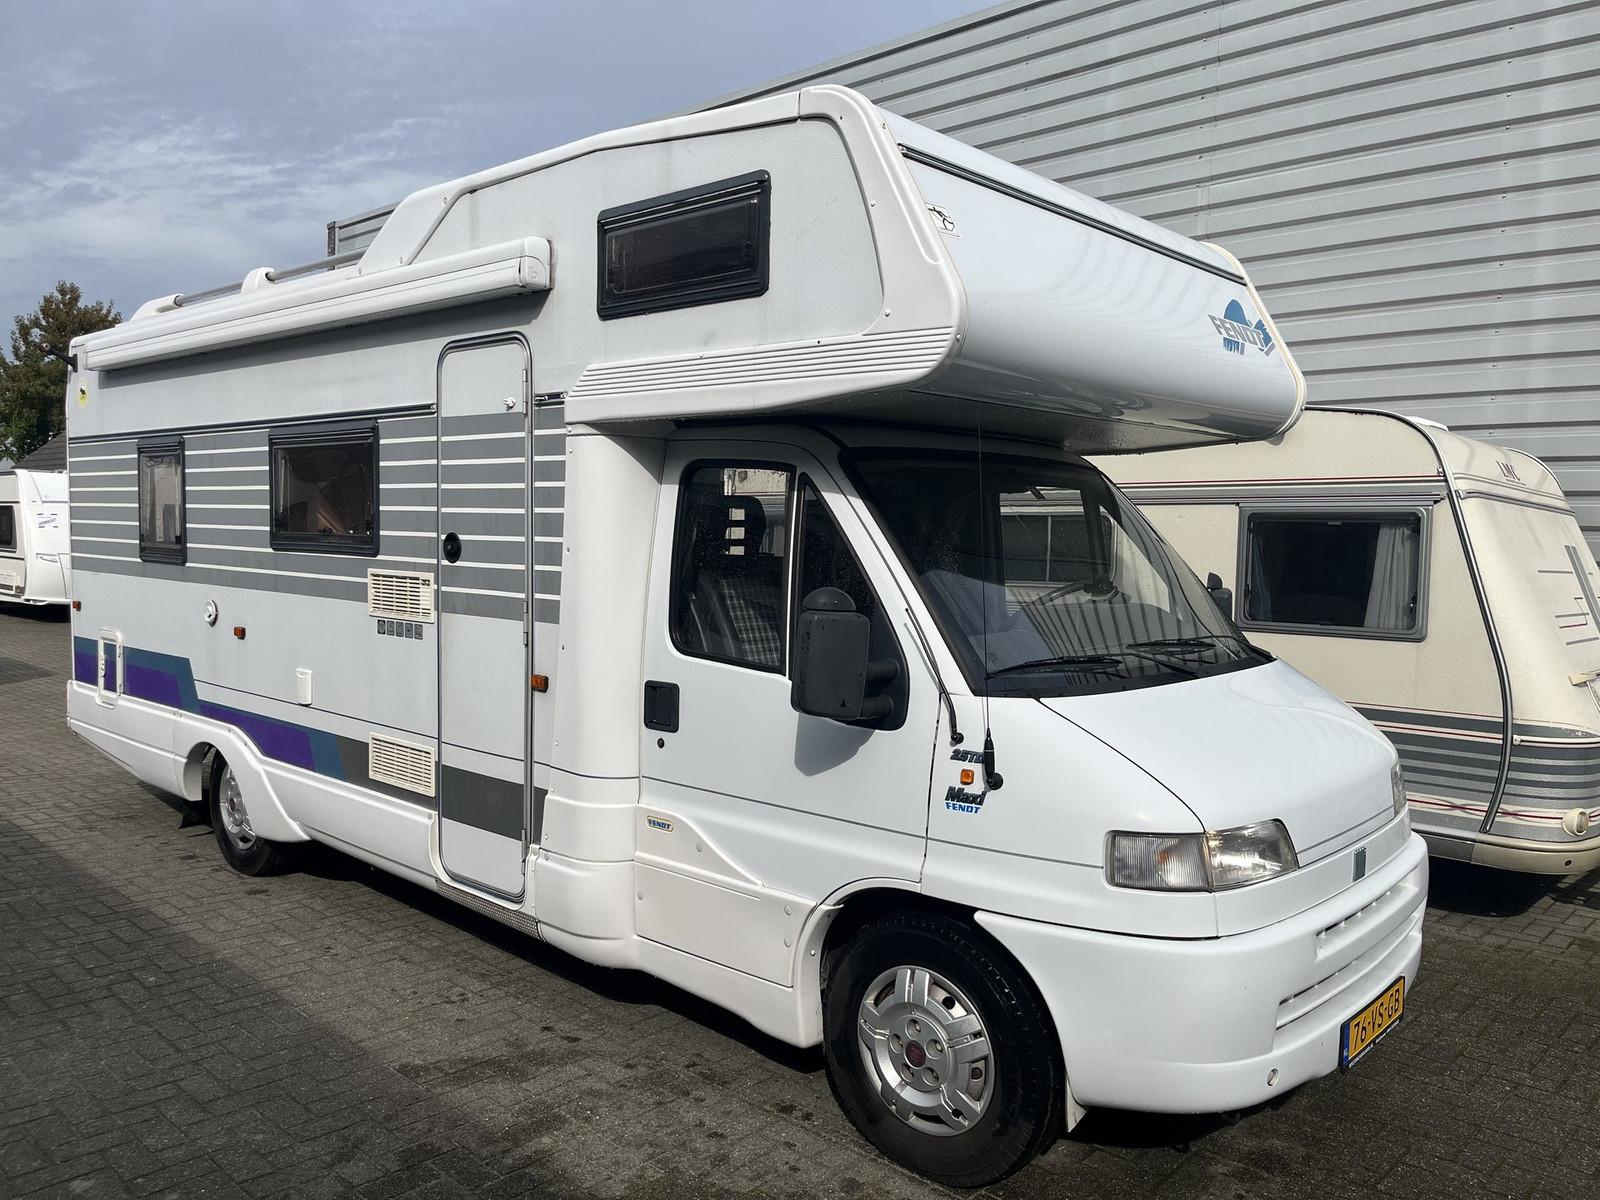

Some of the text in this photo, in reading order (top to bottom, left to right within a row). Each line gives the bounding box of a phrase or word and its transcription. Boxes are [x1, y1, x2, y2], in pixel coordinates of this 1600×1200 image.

[1496, 460, 1520, 481] LMC
[945, 785, 987, 806] Maxi
[945, 801, 981, 814] FENDT
[648, 819, 671, 830] FENDT
[1353, 987, 1400, 1051] 76-VS-GB
